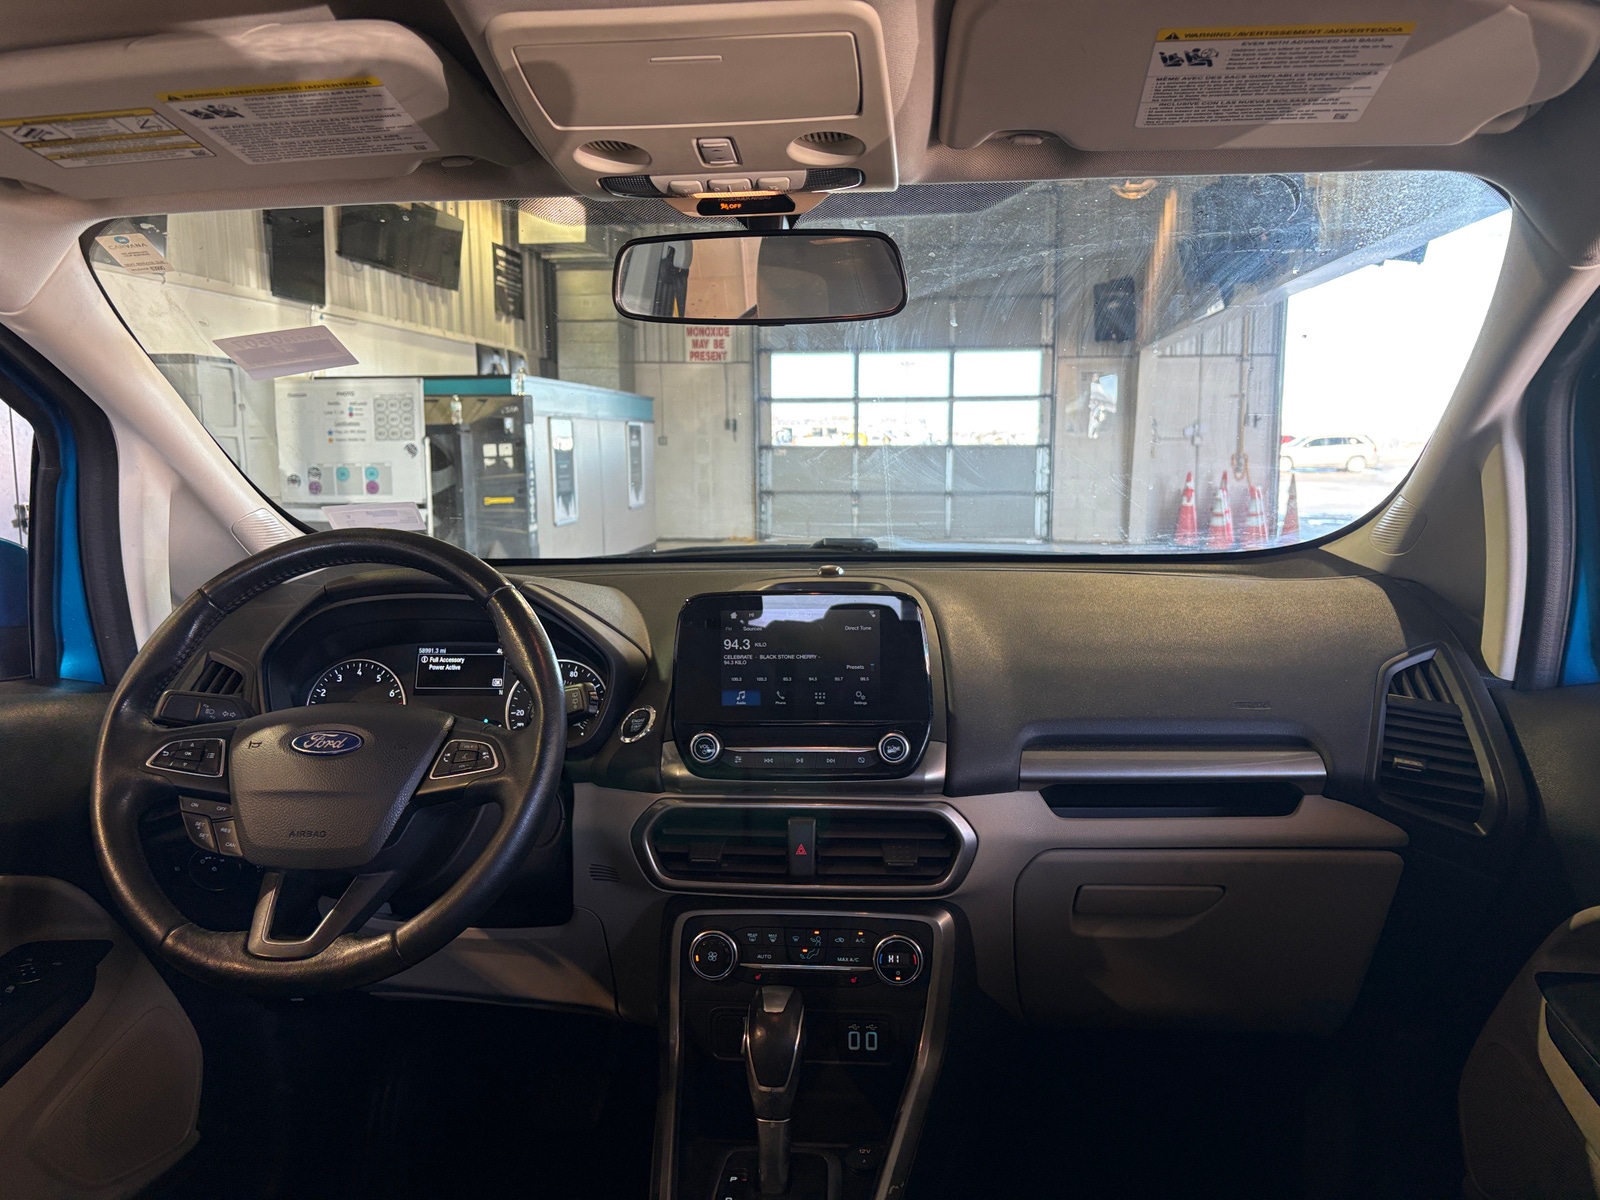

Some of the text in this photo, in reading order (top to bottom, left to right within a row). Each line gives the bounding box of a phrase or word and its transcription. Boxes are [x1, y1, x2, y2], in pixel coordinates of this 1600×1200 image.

[108, 241, 149, 250] CARVANA
[686, 327, 730, 337] MONOXIDE
[692, 339, 725, 349] MAY BE
[689, 351, 727, 361] PRESENT
[723, 639, 751, 650] 94.3
[439, 656, 466, 664] Accessory
[336, 674, 343, 683] 3
[376, 674, 382, 682] 5
[320, 688, 327, 697] 2
[389, 689, 395, 697] 6
[303, 733, 349, 749] Ford
[289, 830, 328, 838] AIRBAG
[888, 955, 900, 963] HI
